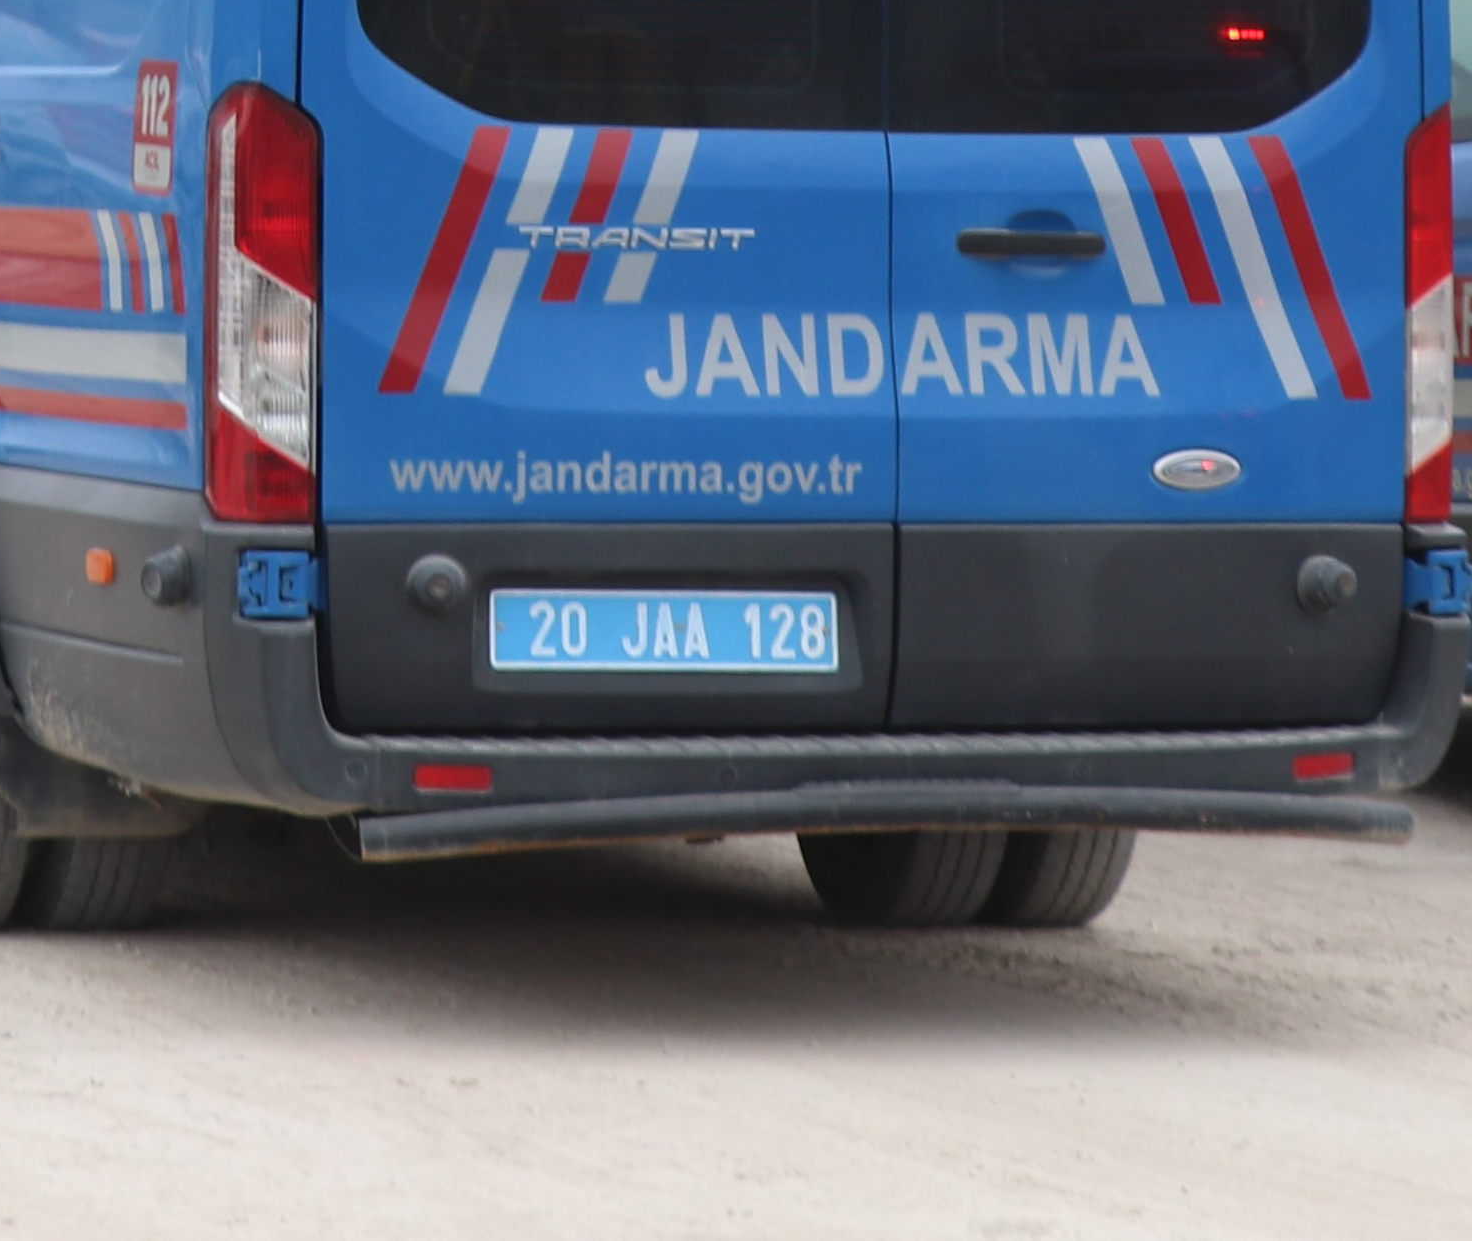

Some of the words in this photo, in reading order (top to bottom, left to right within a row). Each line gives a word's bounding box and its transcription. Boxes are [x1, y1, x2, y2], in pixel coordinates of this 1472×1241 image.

[141, 73, 171, 137] 112
[519, 225, 756, 251] TRANSIT
[644, 312, 1162, 399] JANDARMA
[389, 450, 863, 505] www.jandarma.gov.tr
[529, 600, 588, 658] 20
[621, 601, 711, 659] JAA
[742, 602, 827, 660] 128
